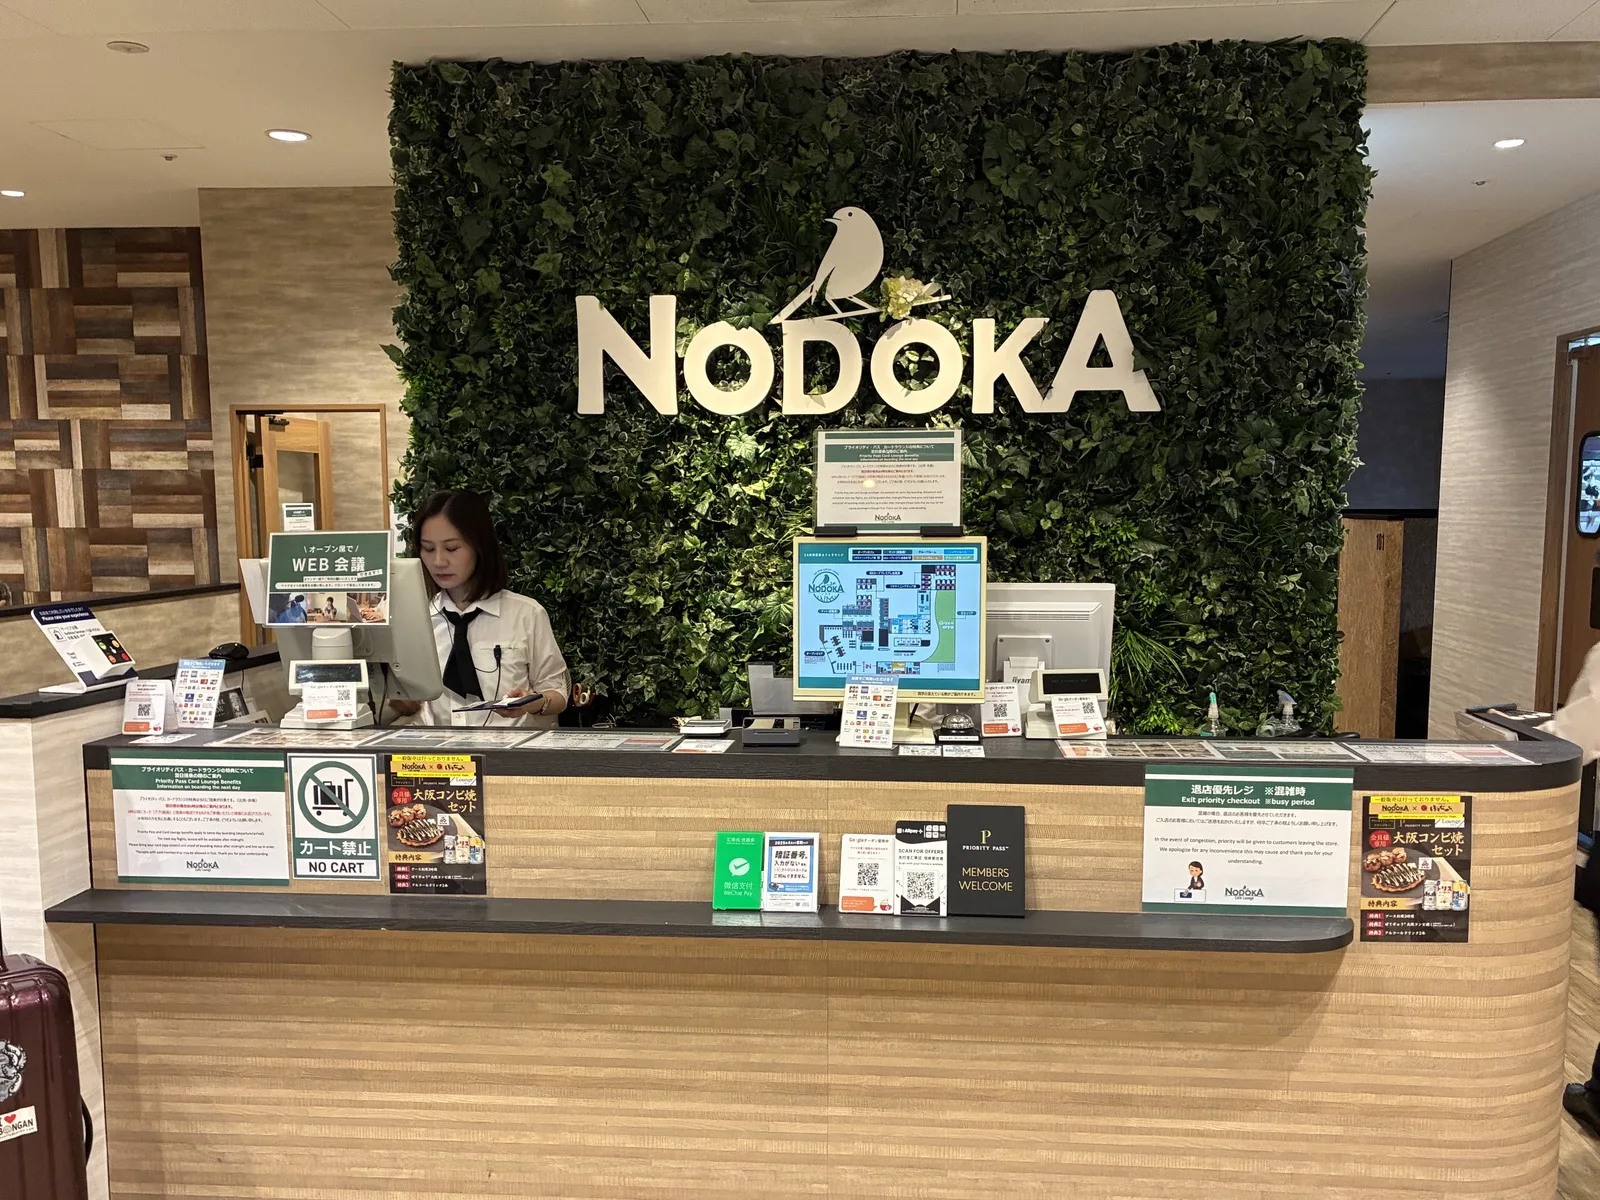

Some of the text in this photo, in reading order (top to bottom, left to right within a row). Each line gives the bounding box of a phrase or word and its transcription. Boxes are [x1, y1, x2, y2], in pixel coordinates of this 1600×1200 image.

[575, 289, 1161, 416] NODOKA
[309, 545, 354, 553] オープン席で
[292, 556, 366, 572] WEB 会議
[808, 583, 845, 593] NODOKA
[412, 788, 477, 801] 大阪コンビ焼
[1191, 784, 1307, 797] 退店優先レジ ※混雑時
[447, 801, 476, 813] セット
[1181, 796, 1197, 804] Exit
[1197, 796, 1226, 805] priority
[1226, 797, 1261, 805] checkout
[1290, 798, 1316, 807] period
[1381, 804, 1409, 812] NODOKA
[980, 829, 992, 845] P
[1392, 831, 1465, 844] 大阪コンビ焼
[300, 841, 372, 856] カート禁止
[1431, 844, 1464, 857] セット
[394, 852, 422, 861] 特典内容
[1227, 858, 1264, 866] understanding.
[186, 860, 220, 869] NODOKA
[308, 861, 364, 873] NO CART
[962, 867, 1010, 878] MEMBERS
[723, 881, 753, 890] 微信支付
[958, 880, 1013, 892] WELCOME
[1225, 887, 1265, 897] NODOKA
[1367, 900, 1398, 908] 特典内容
